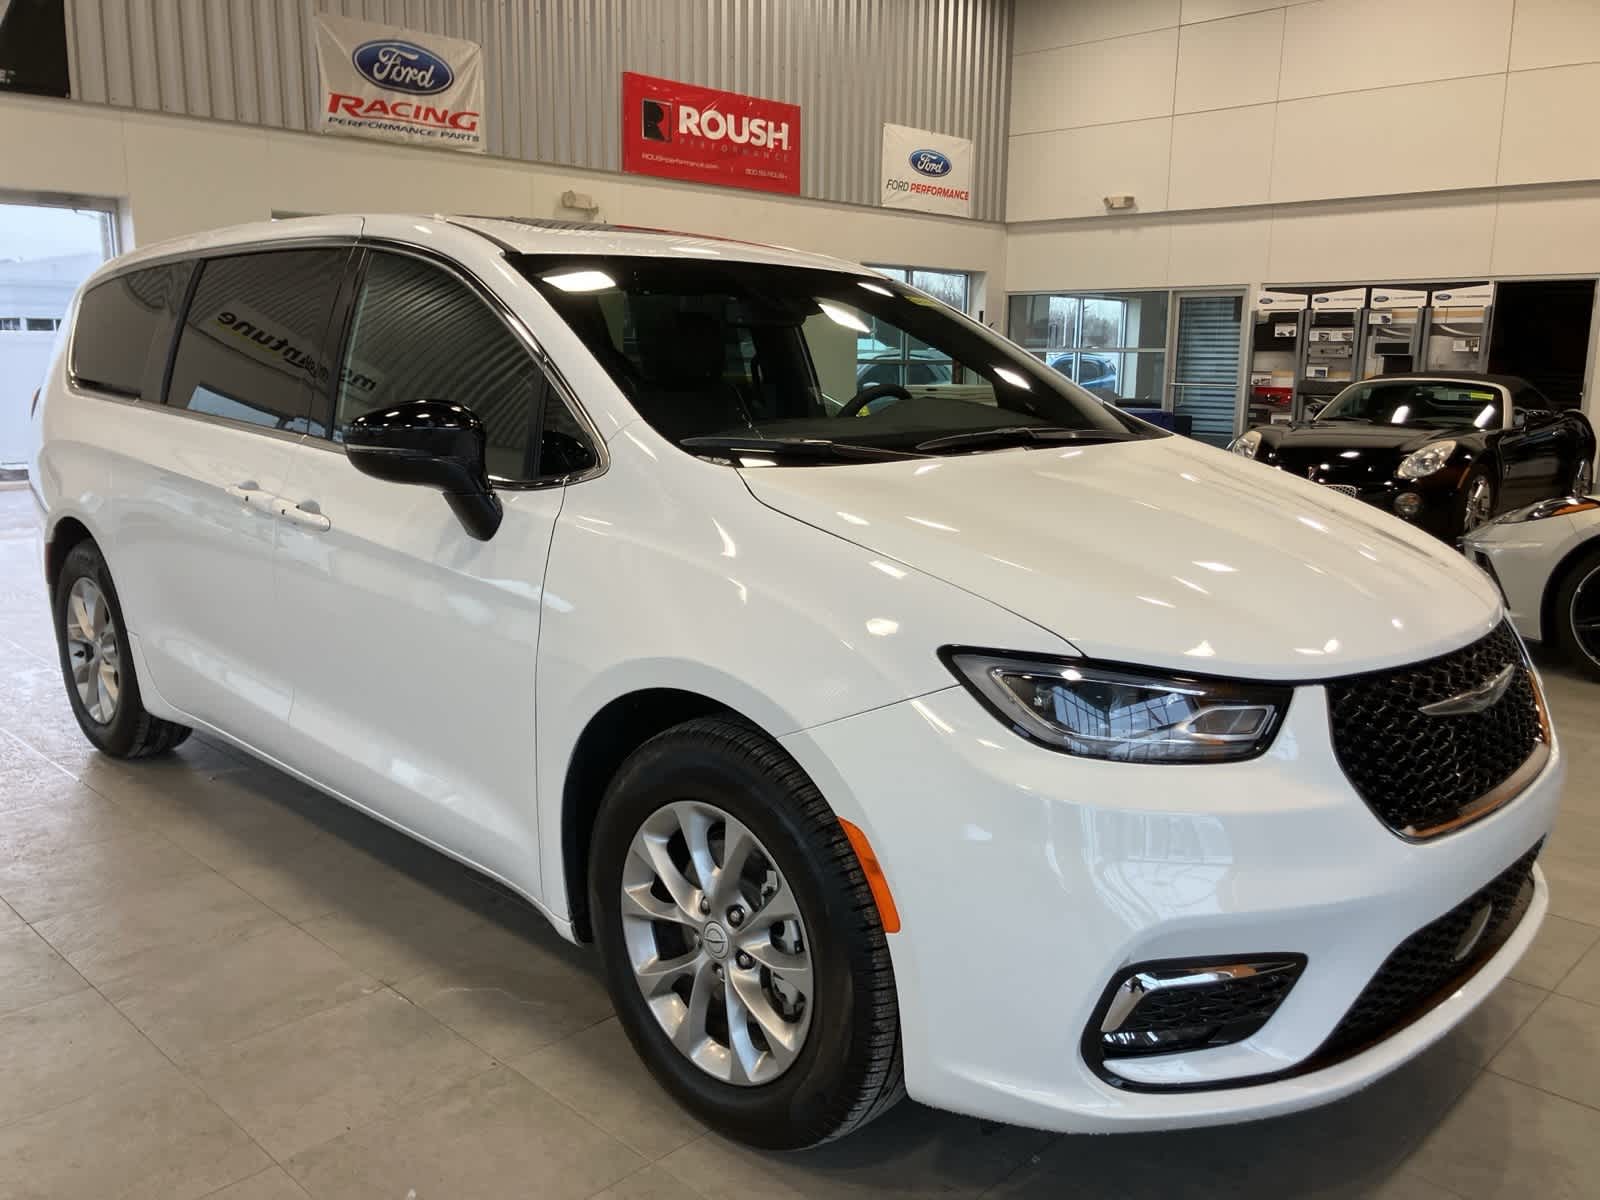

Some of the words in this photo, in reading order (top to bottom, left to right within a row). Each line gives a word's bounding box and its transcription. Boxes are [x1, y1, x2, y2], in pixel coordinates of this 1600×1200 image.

[373, 47, 434, 88] Ford
[328, 92, 479, 131] RACING
[679, 101, 789, 150] ROUSH
[328, 117, 433, 136] PERFORMANCE
[440, 131, 479, 142] PARTS
[917, 153, 943, 173] Ford
[886, 179, 909, 192] FORD
[909, 183, 969, 201] PERFORMANCE
